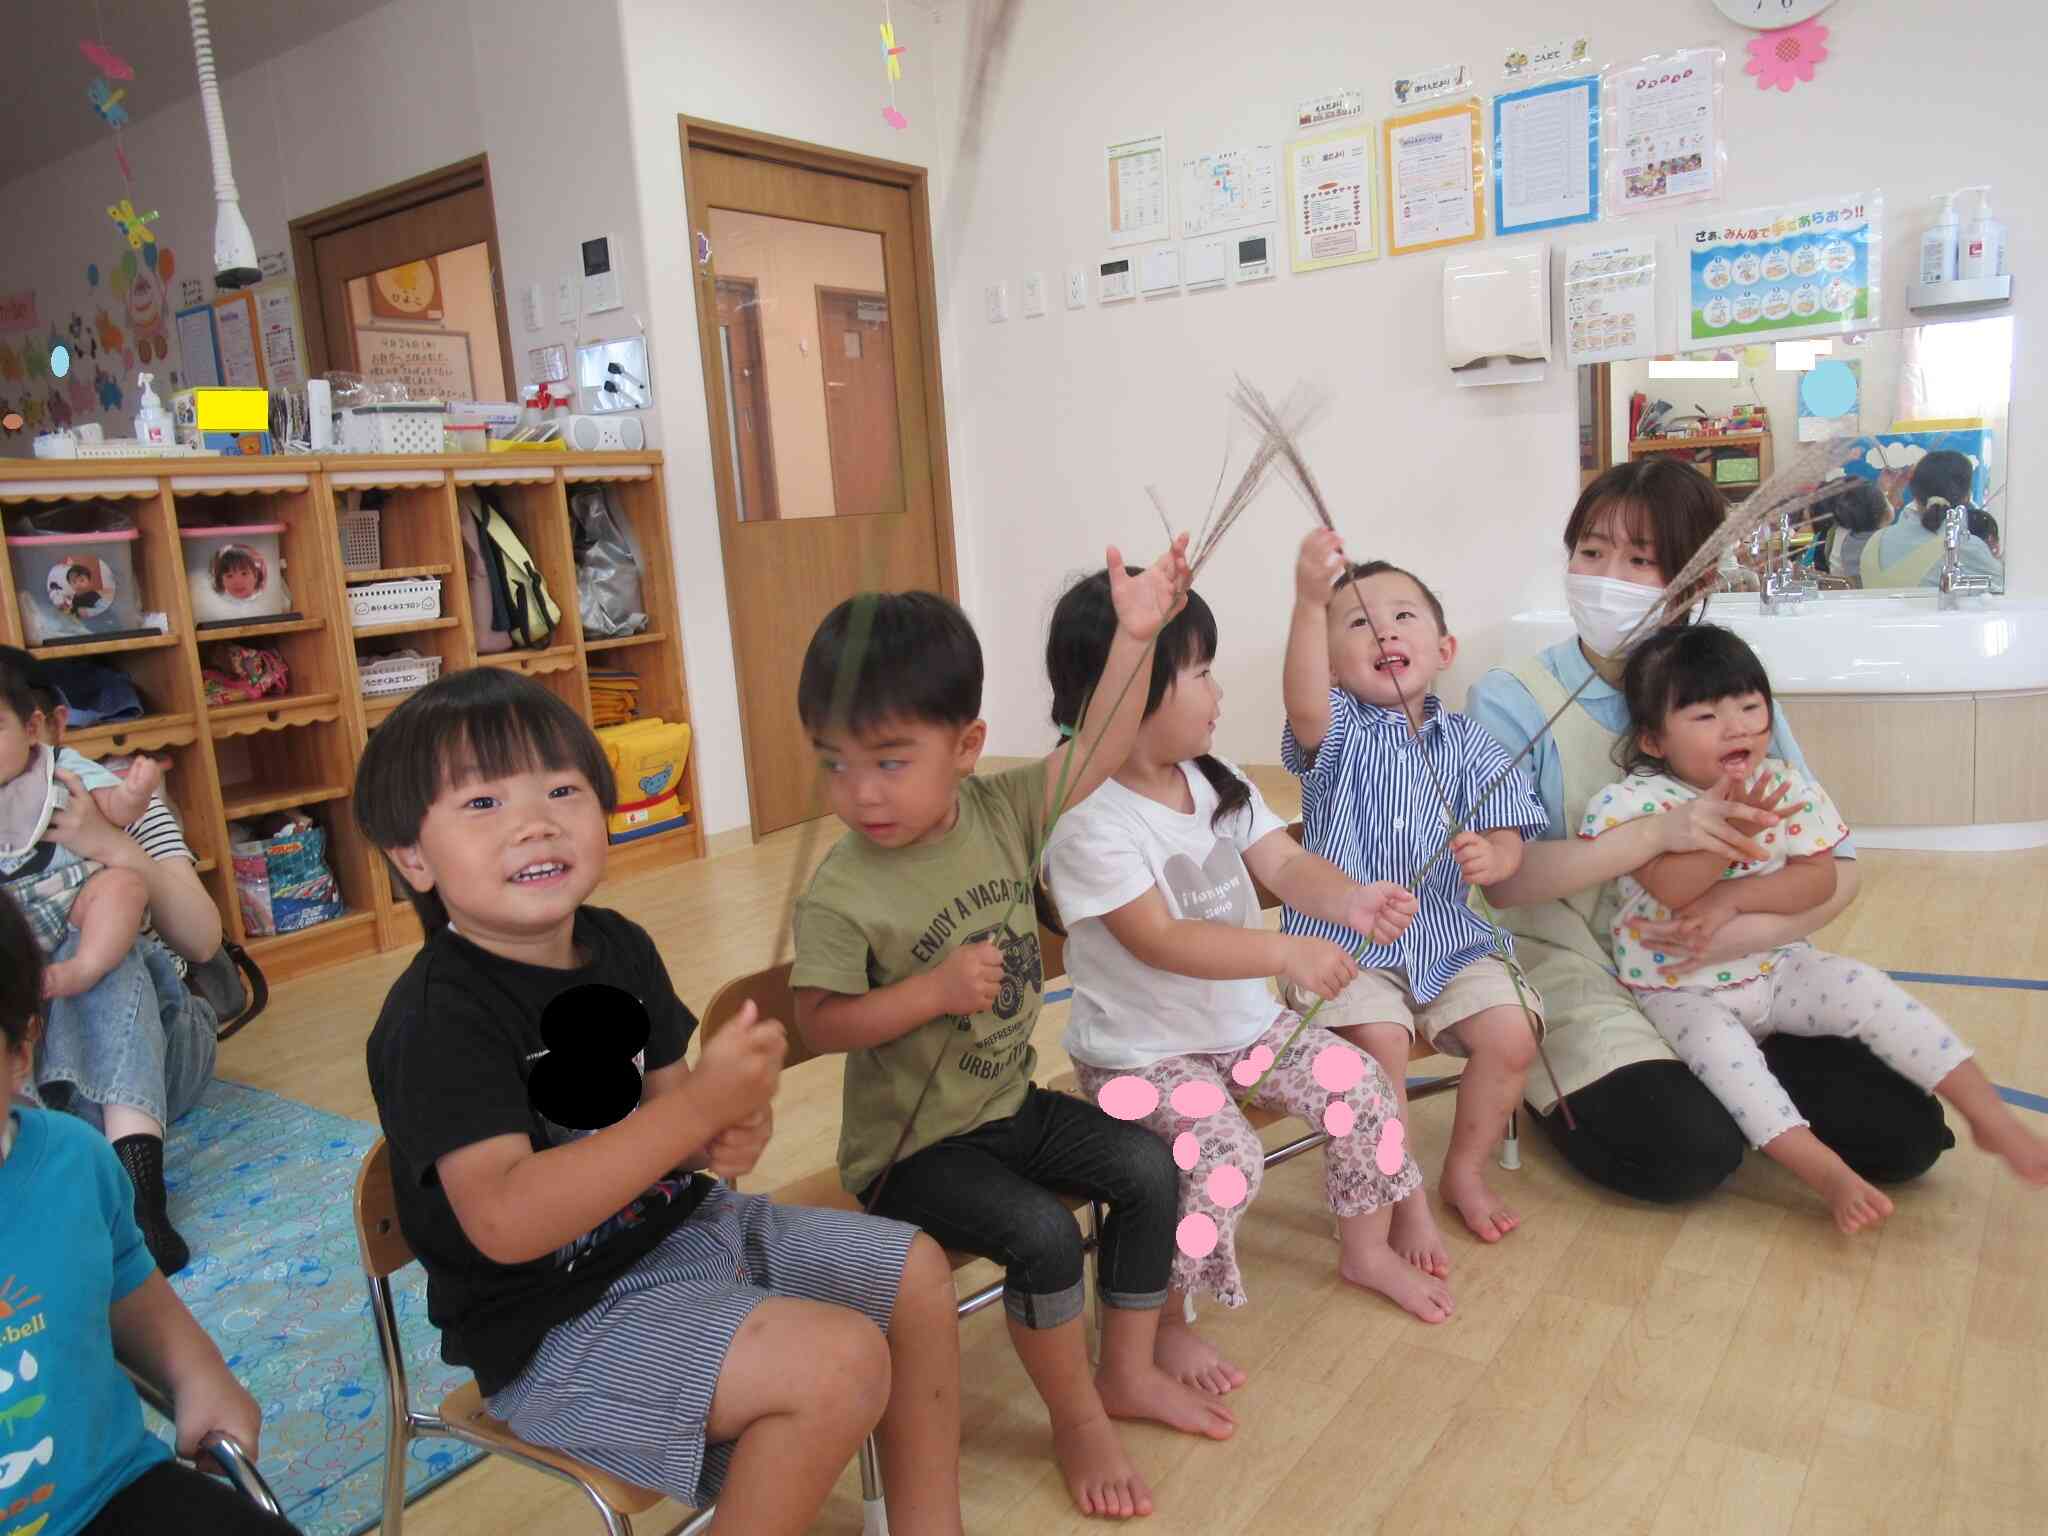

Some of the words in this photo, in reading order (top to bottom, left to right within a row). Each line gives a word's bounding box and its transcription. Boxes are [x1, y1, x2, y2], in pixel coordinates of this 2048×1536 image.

[391, 289, 424, 306] ひよこ
[911, 908, 957, 963] ENJOY
[954, 897, 971, 920] A
[966, 877, 1034, 911] VACAON
